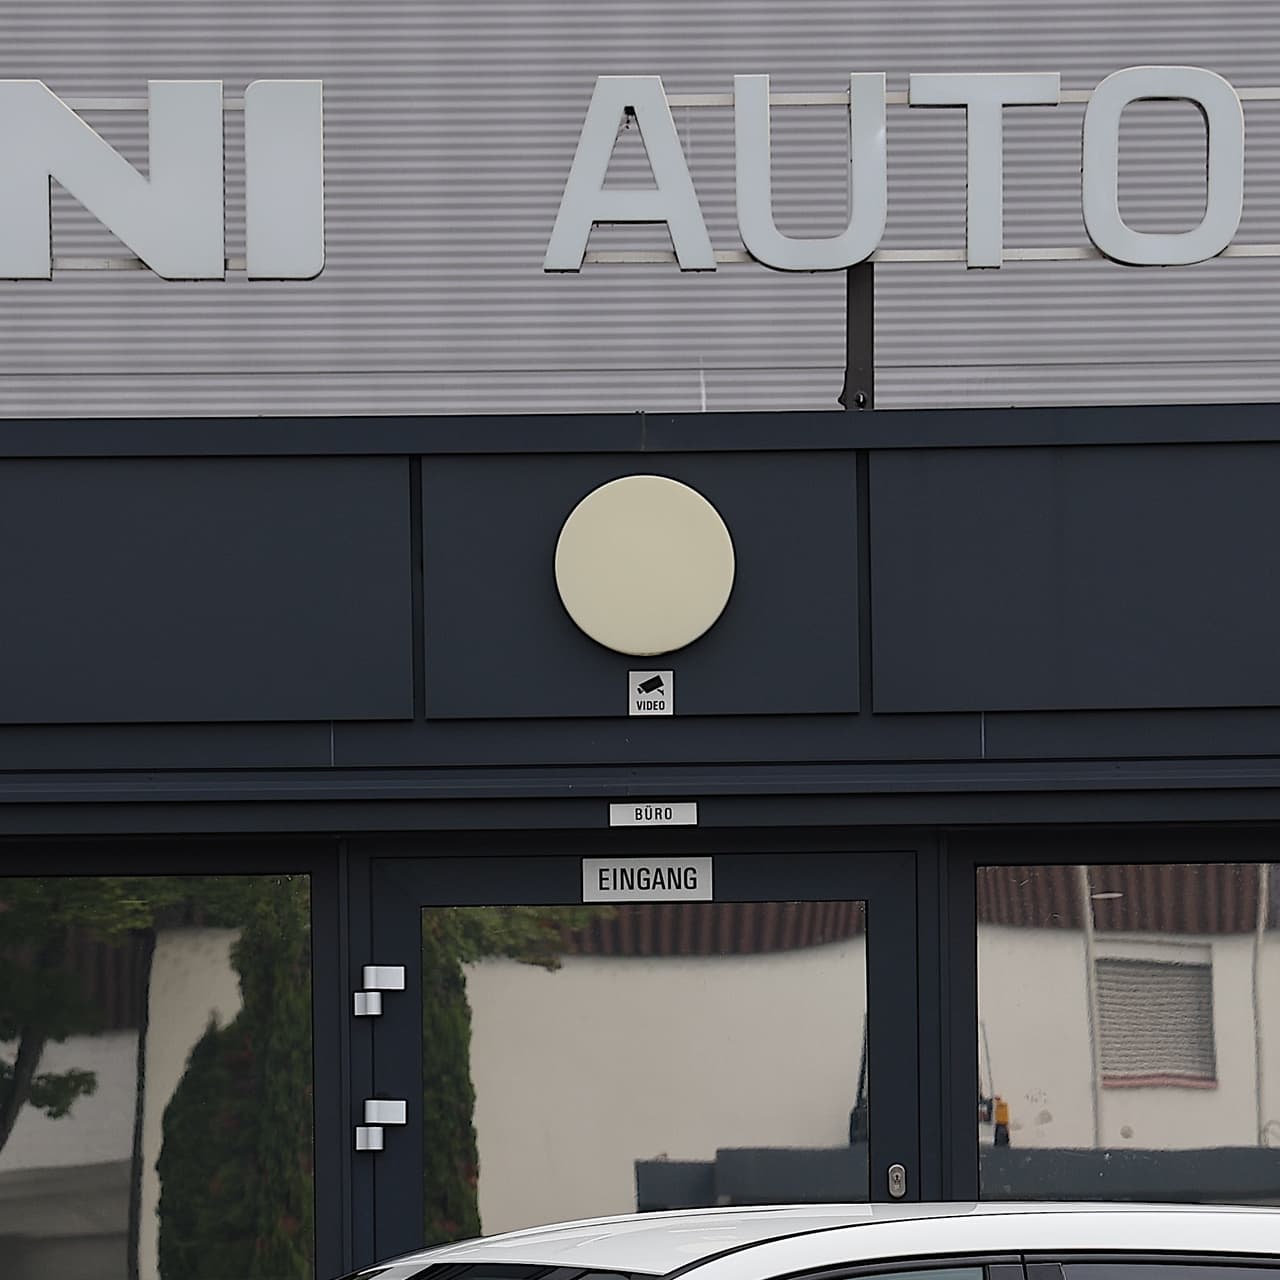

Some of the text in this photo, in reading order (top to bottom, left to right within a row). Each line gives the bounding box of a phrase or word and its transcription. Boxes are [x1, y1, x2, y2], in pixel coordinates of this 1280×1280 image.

[543, 65, 1246, 273] AUTO
[636, 700, 666, 711] VIDEO
[634, 805, 674, 821] BÜRO
[598, 867, 698, 891] EINGANG
